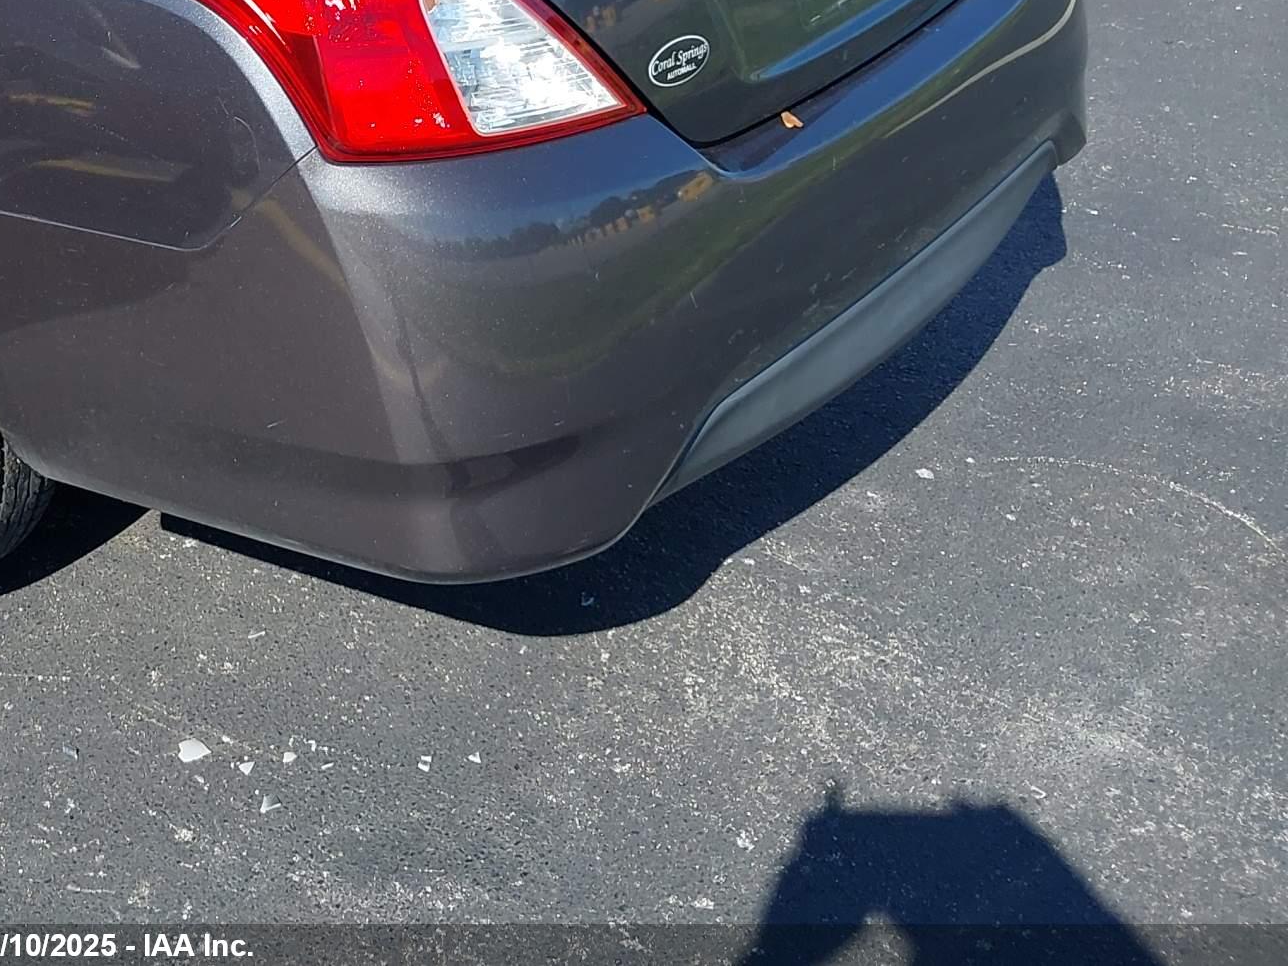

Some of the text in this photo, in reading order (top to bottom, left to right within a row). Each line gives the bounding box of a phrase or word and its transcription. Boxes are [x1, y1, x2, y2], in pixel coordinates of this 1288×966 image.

[651, 42, 708, 77] Coral Springs
[666, 63, 697, 81] AUTOMALL
